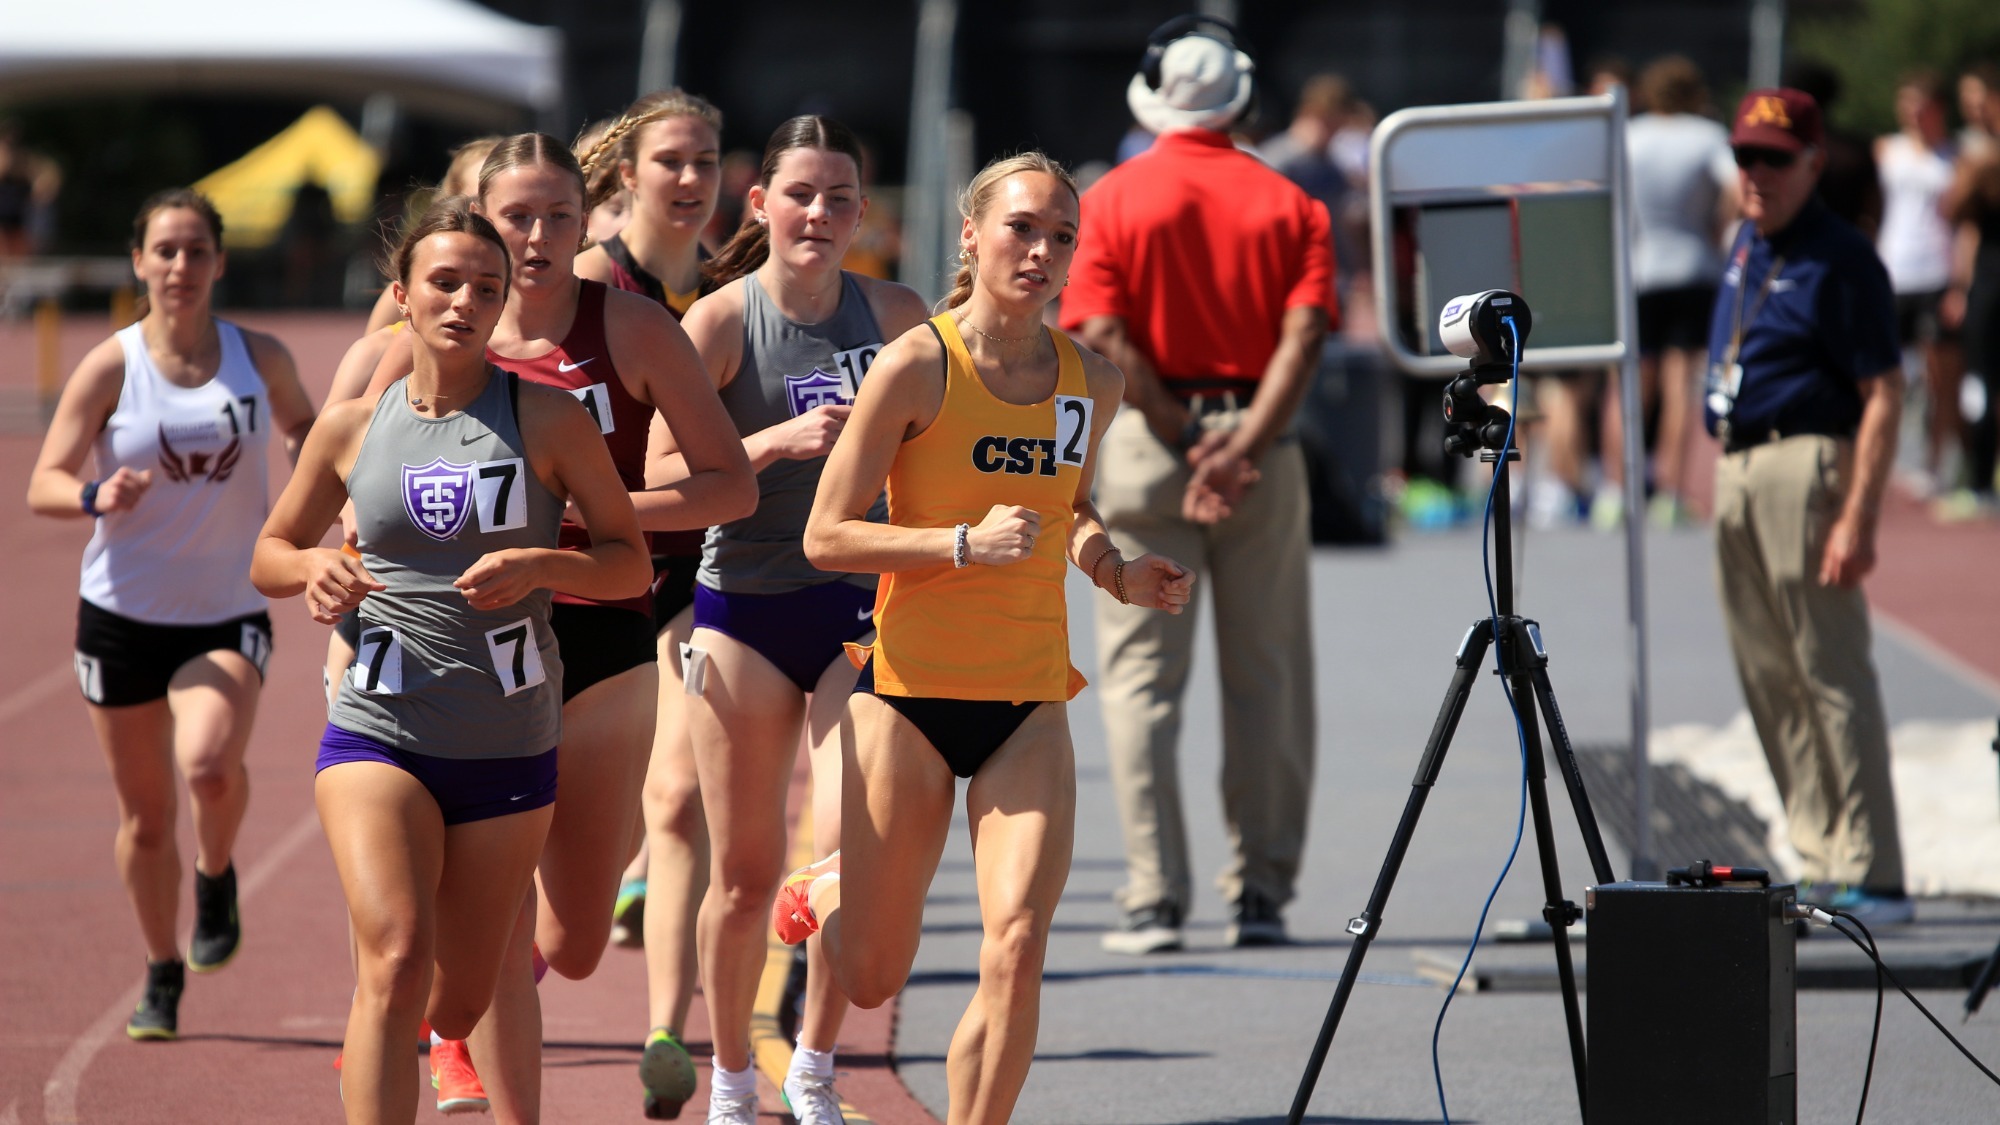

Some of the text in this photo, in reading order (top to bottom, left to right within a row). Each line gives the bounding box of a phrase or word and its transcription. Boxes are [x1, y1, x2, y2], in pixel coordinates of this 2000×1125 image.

[222, 396, 257, 435] 17
[1063, 400, 1086, 464] 2
[479, 464, 517, 527] 7
[363, 630, 393, 691] 7
[493, 624, 528, 688] 7
